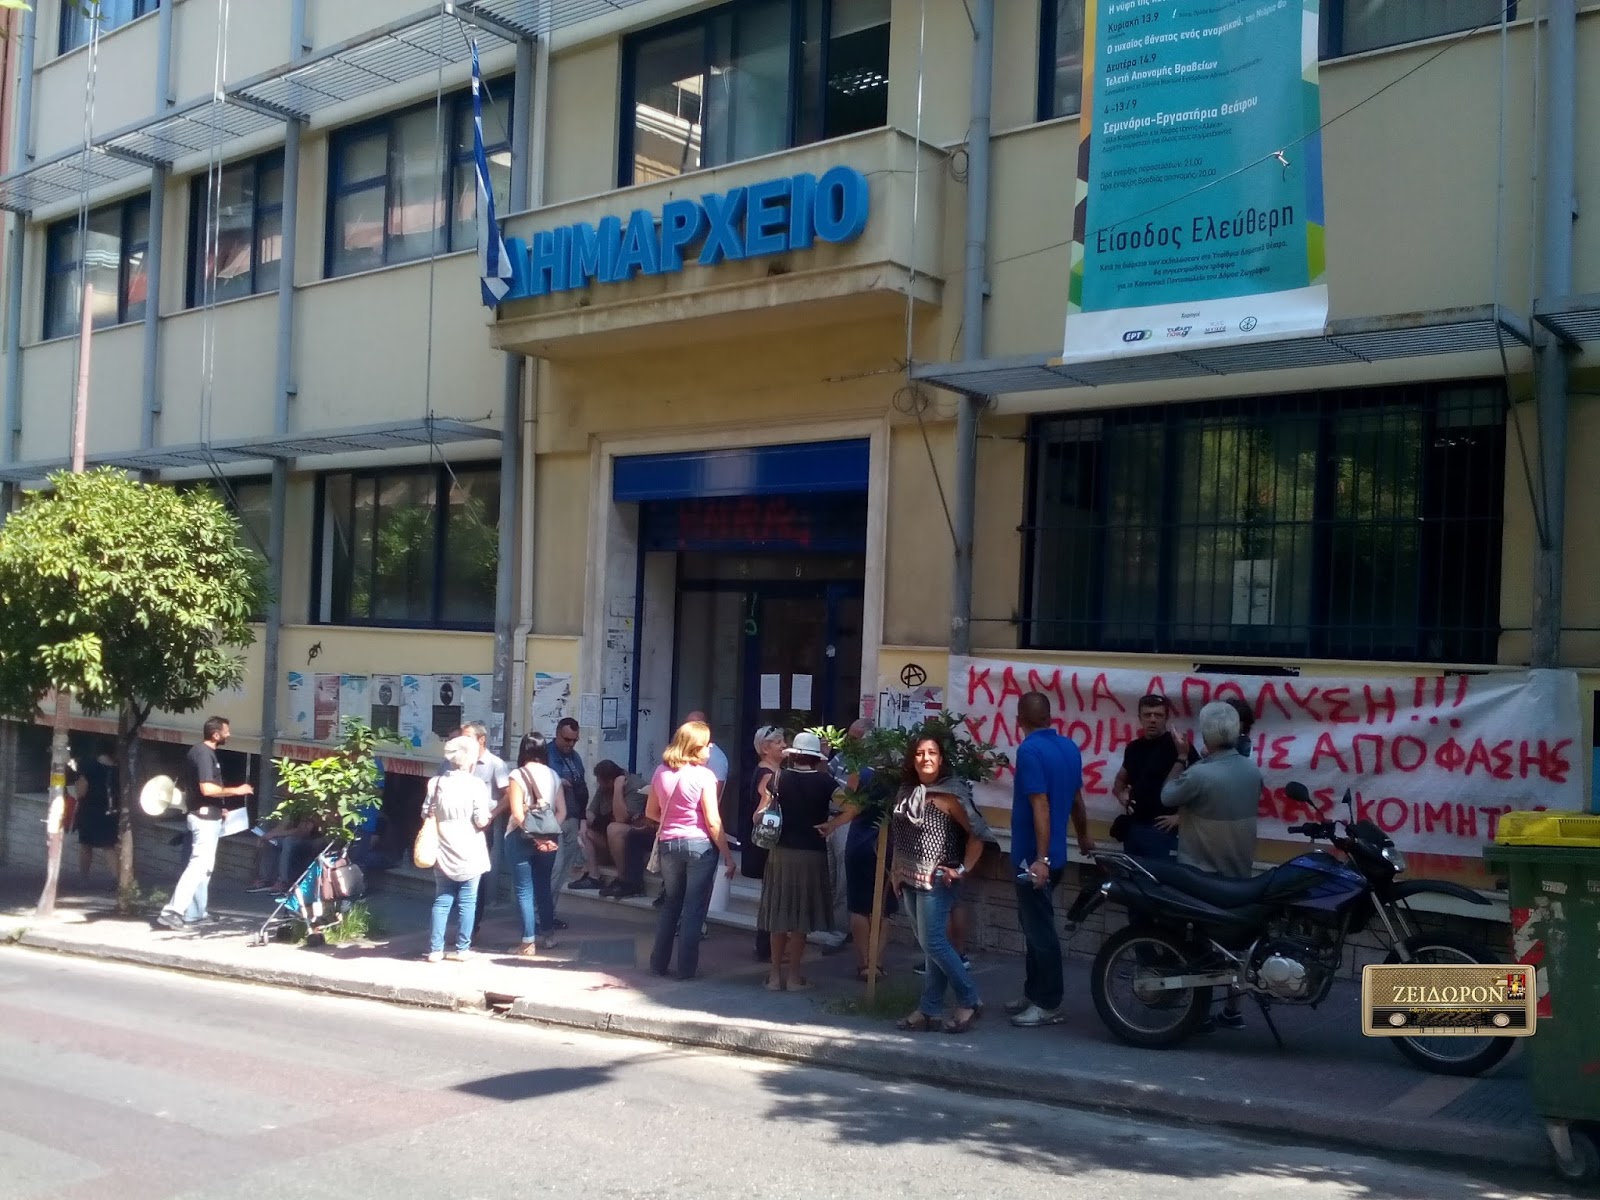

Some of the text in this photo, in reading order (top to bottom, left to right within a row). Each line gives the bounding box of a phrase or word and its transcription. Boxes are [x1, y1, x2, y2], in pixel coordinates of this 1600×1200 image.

[1108, 12, 1159, 33] Κυριακή 13.9
[1114, 38, 1143, 53] τυχαίος
[1180, 28, 1200, 40] ενός
[1105, 73, 1130, 87] Τελετή
[1131, 66, 1172, 81] Απονομής
[1174, 60, 1218, 76] Βραβείων
[1106, 53, 1157, 73] Δευτέρα 14.9
[1103, 108, 1218, 135] Σεμινάρια-Εργαστήρια
[499, 165, 869, 301] ΔΗΜΑΡΧΕΙΟ
[1097, 206, 1293, 254] Είσοδος Ελεύθερη
[967, 665, 1126, 712] ΚΑΜΙΑ
[1310, 731, 1573, 783] ΑΠΟΦΑΣΗΣ
